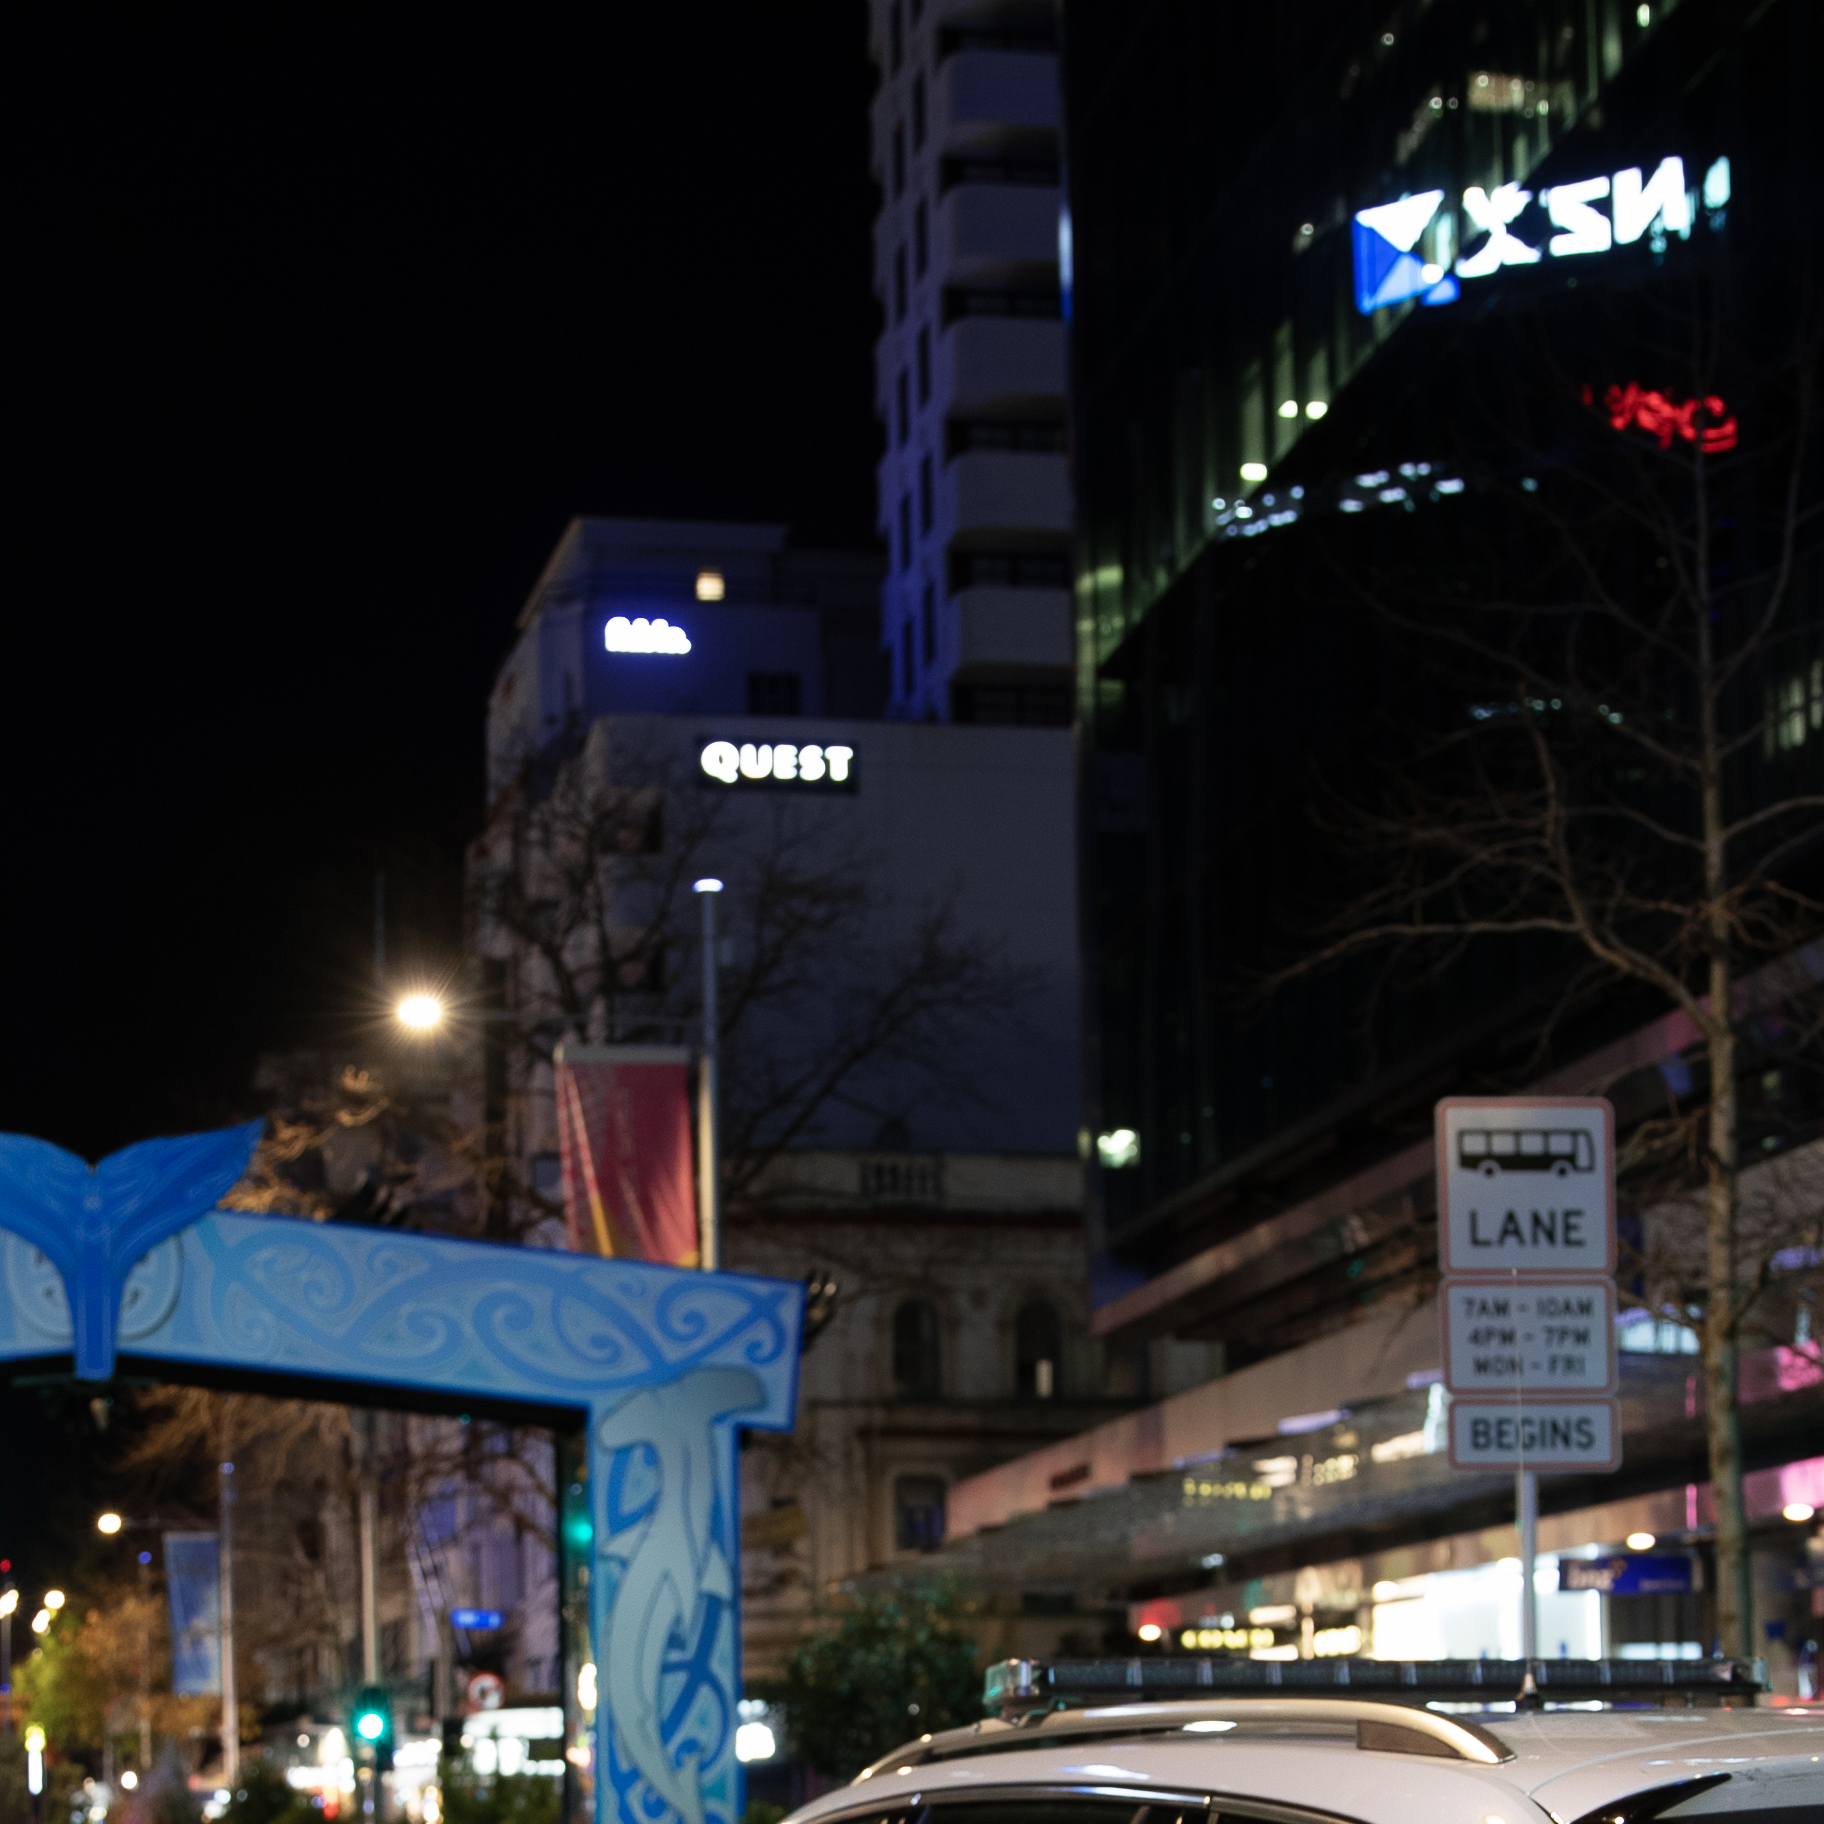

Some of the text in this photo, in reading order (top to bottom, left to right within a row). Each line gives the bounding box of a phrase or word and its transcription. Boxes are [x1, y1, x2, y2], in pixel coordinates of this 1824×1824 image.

[700, 740, 854, 784] QUEST
[1468, 1208, 1587, 1247] LANE
[1463, 1298, 1511, 1319] 7AM
[1542, 1326, 1591, 1347] 7PM
[1473, 1355, 1524, 1376] MON
[1547, 1355, 1587, 1376] FRI
[1471, 1417, 1596, 1450] BEGINS
